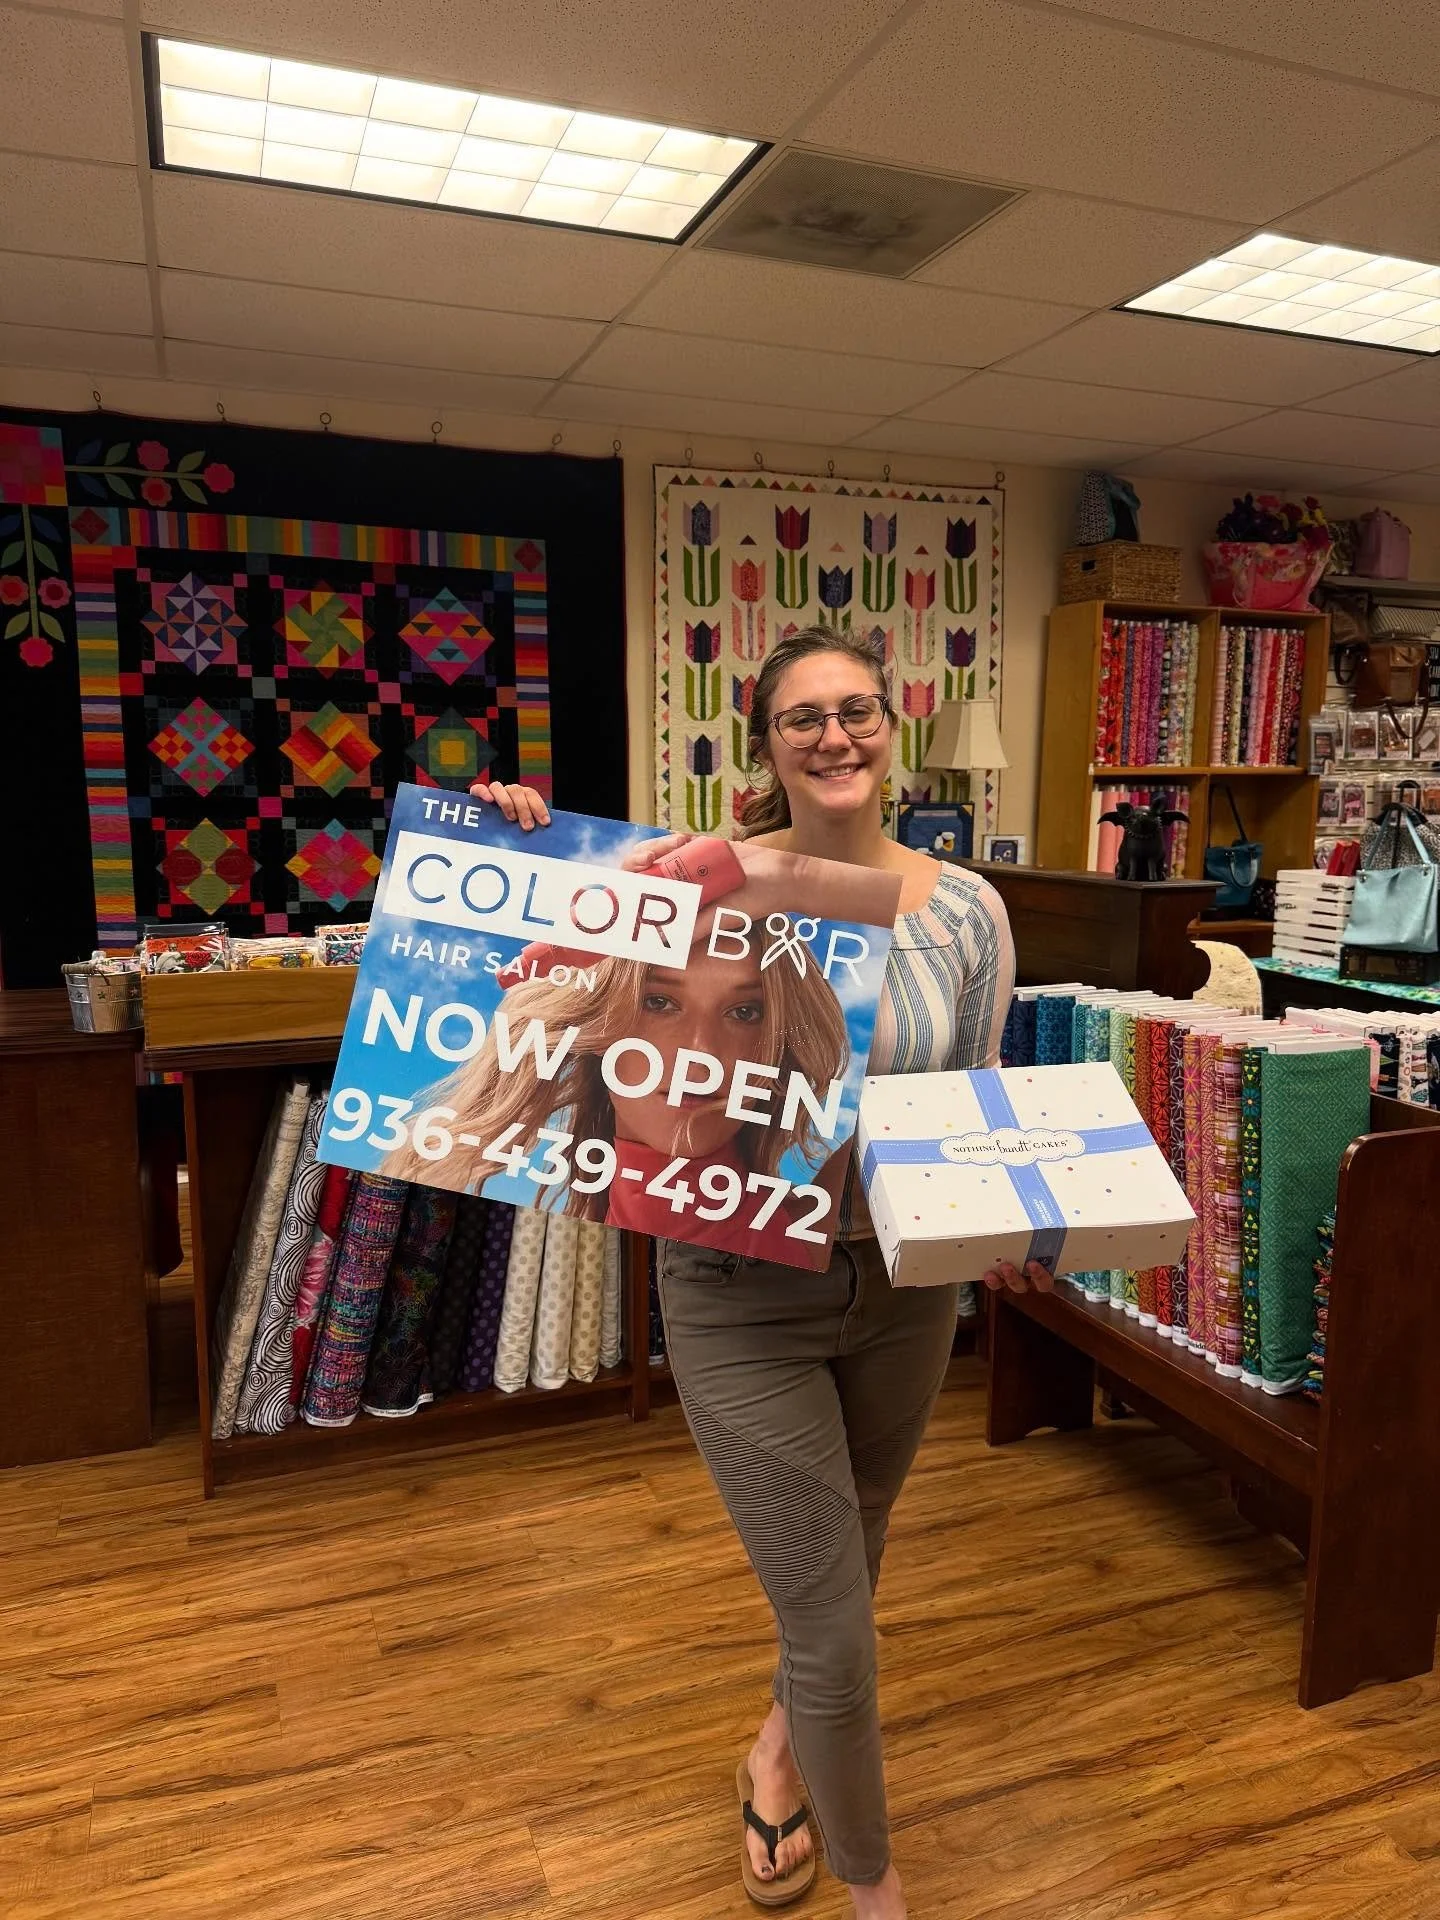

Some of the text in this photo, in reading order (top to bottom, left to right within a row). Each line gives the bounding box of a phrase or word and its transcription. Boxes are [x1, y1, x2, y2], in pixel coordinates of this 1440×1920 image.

[421, 797, 482, 828] THE
[406, 853, 678, 949] COLOR
[390, 933, 598, 993] HAIR SALON
[362, 987, 844, 1140] NOW OPEN
[328, 1087, 832, 1245] 936-439-4972
[953, 1144, 996, 1154] NOTHING
[1032, 1140, 1067, 1149] CAKES
